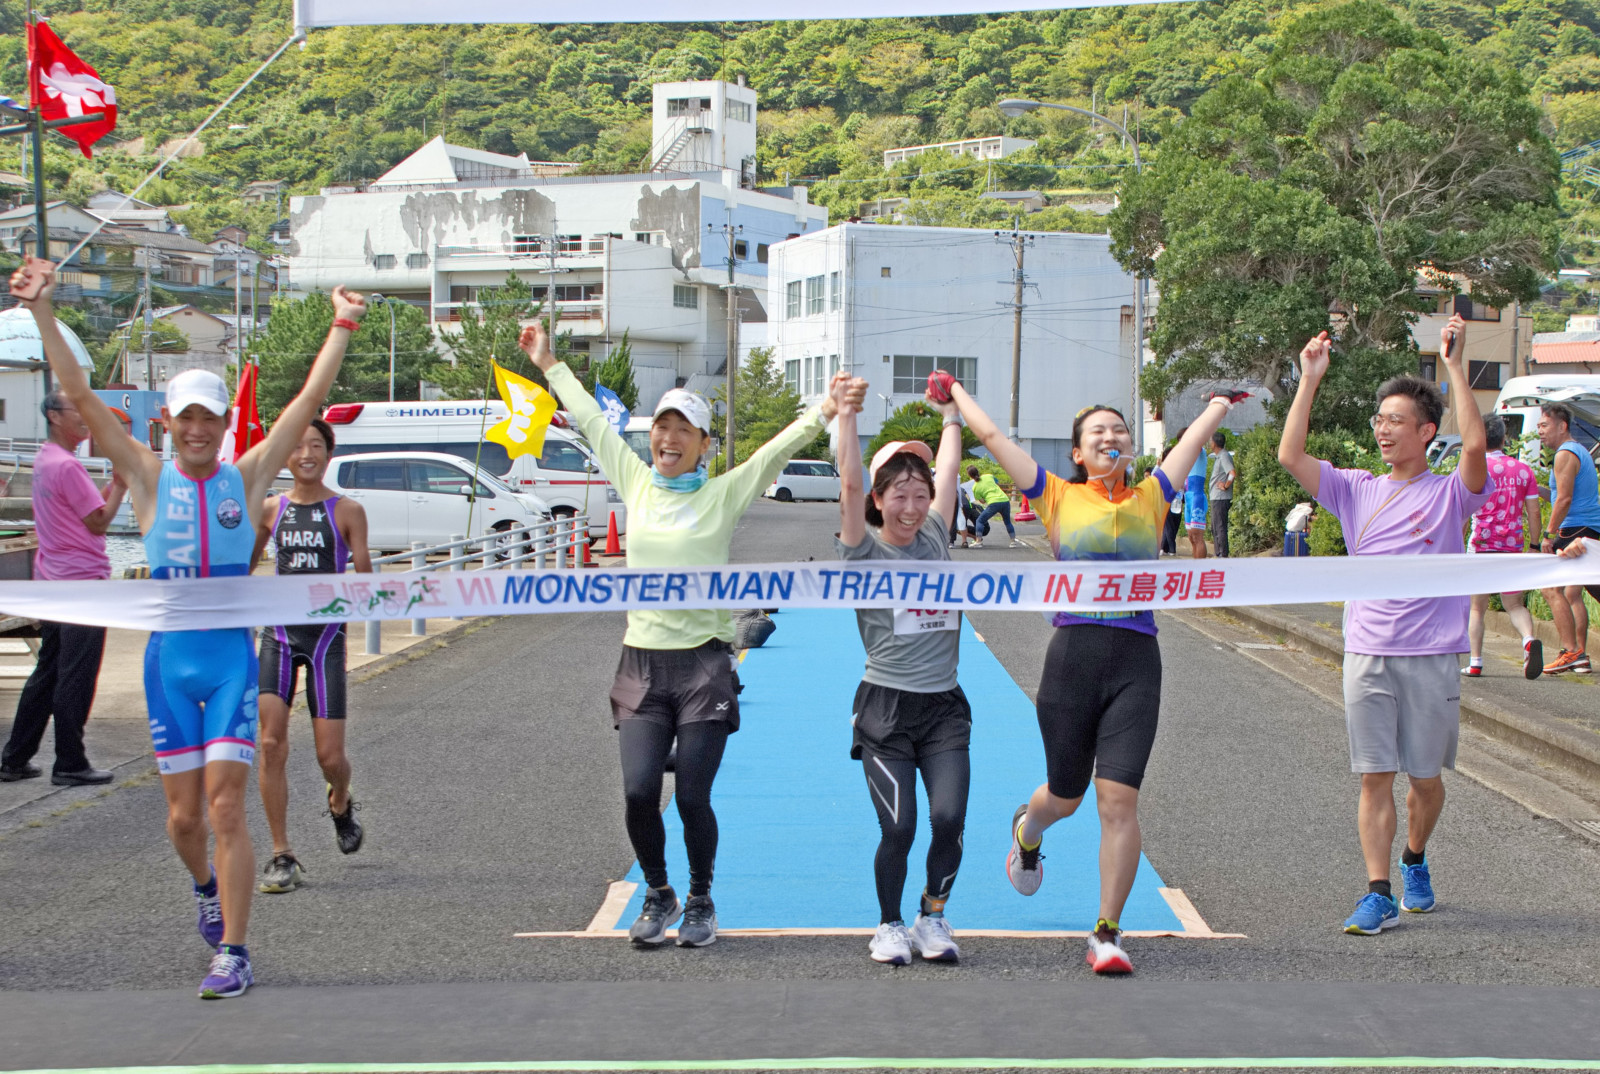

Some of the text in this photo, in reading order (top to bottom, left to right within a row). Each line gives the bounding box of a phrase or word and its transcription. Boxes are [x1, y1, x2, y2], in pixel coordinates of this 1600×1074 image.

[399, 407, 493, 417] HIMEDIC
[281, 530, 326, 548] HARA
[289, 552, 319, 569] JPN
[503, 569, 1227, 604] MONSTER MAN TRIATHLON IN 五島列島
